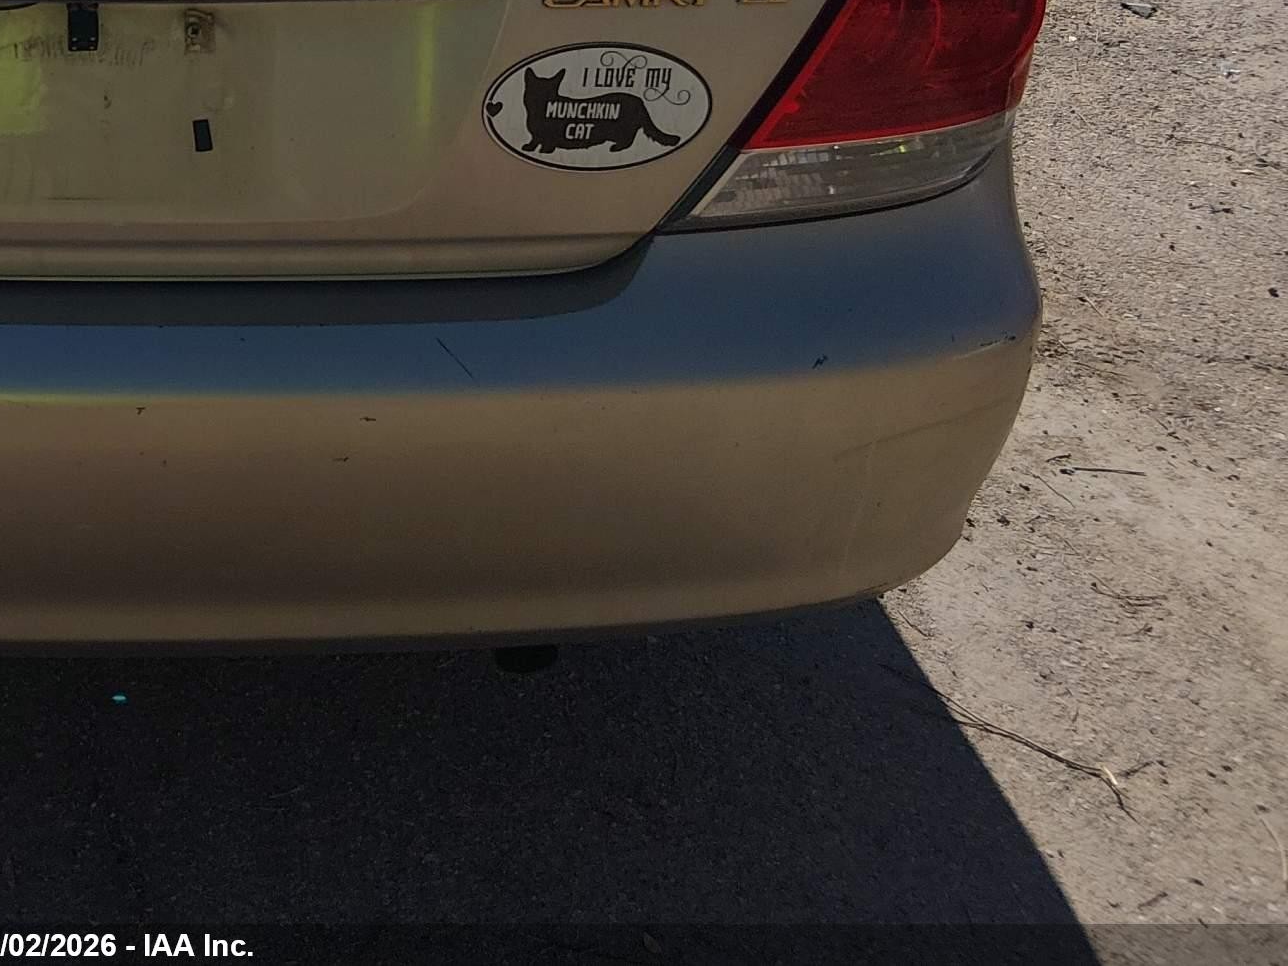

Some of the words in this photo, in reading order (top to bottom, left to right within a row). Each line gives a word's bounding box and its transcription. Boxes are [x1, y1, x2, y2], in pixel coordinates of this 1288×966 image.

[582, 67, 590, 88] I
[594, 61, 640, 88] LOVE
[546, 101, 621, 121] MUNCHKIN
[565, 123, 595, 140] CAT
